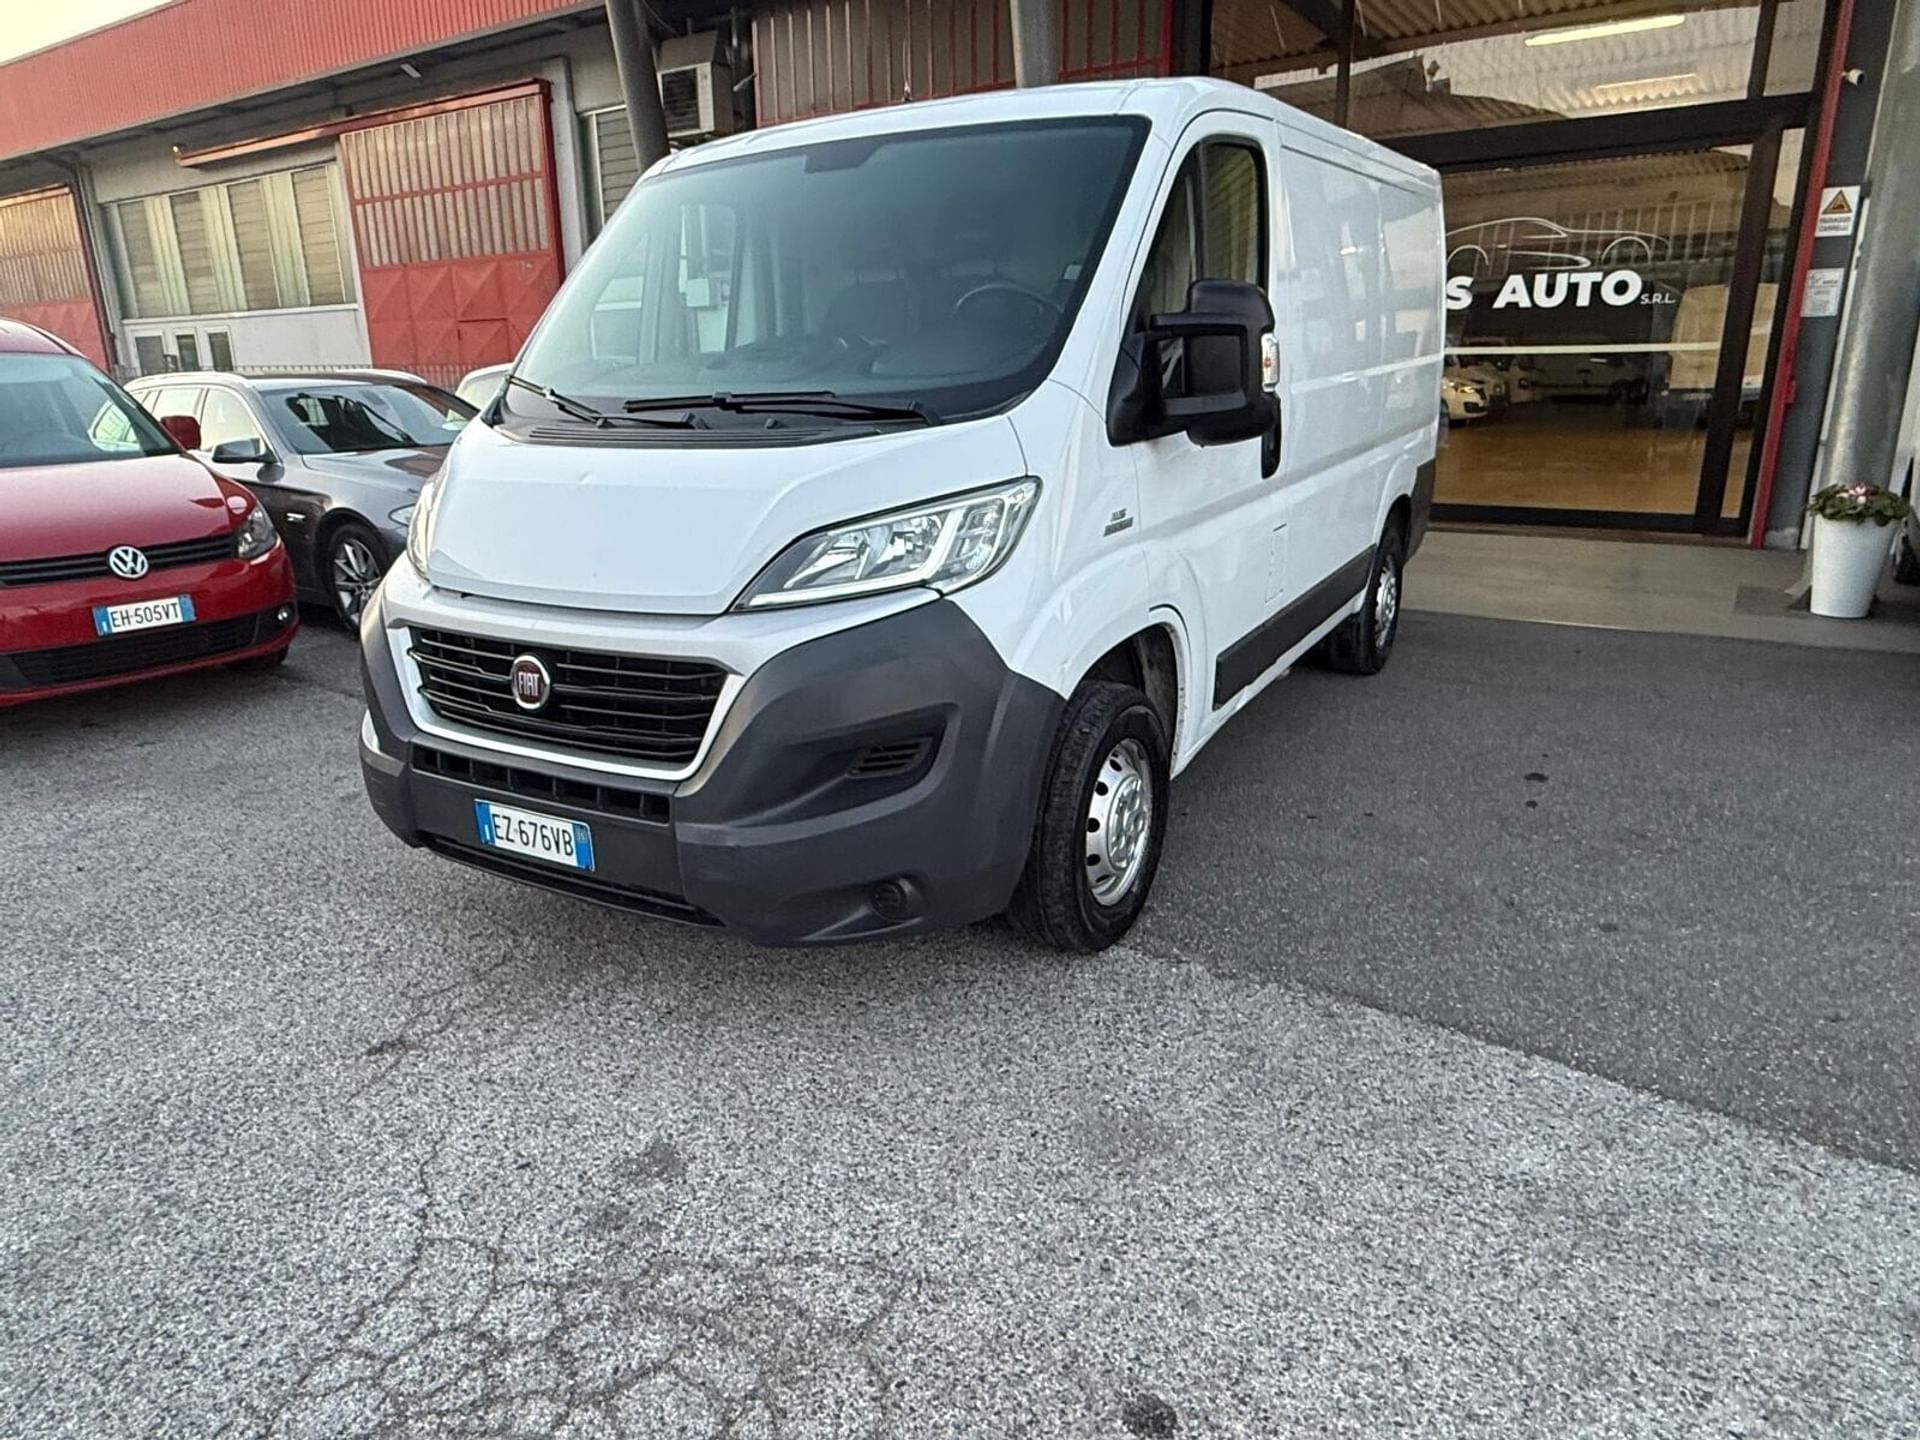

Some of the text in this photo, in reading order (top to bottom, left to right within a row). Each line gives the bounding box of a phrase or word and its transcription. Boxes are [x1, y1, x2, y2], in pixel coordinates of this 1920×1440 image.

[1492, 269, 1643, 309] AUTO
[110, 603, 179, 628] EH 505VT
[518, 671, 540, 696] FIAT
[492, 813, 515, 843] EZ
[518, 820, 574, 856] 676VB
